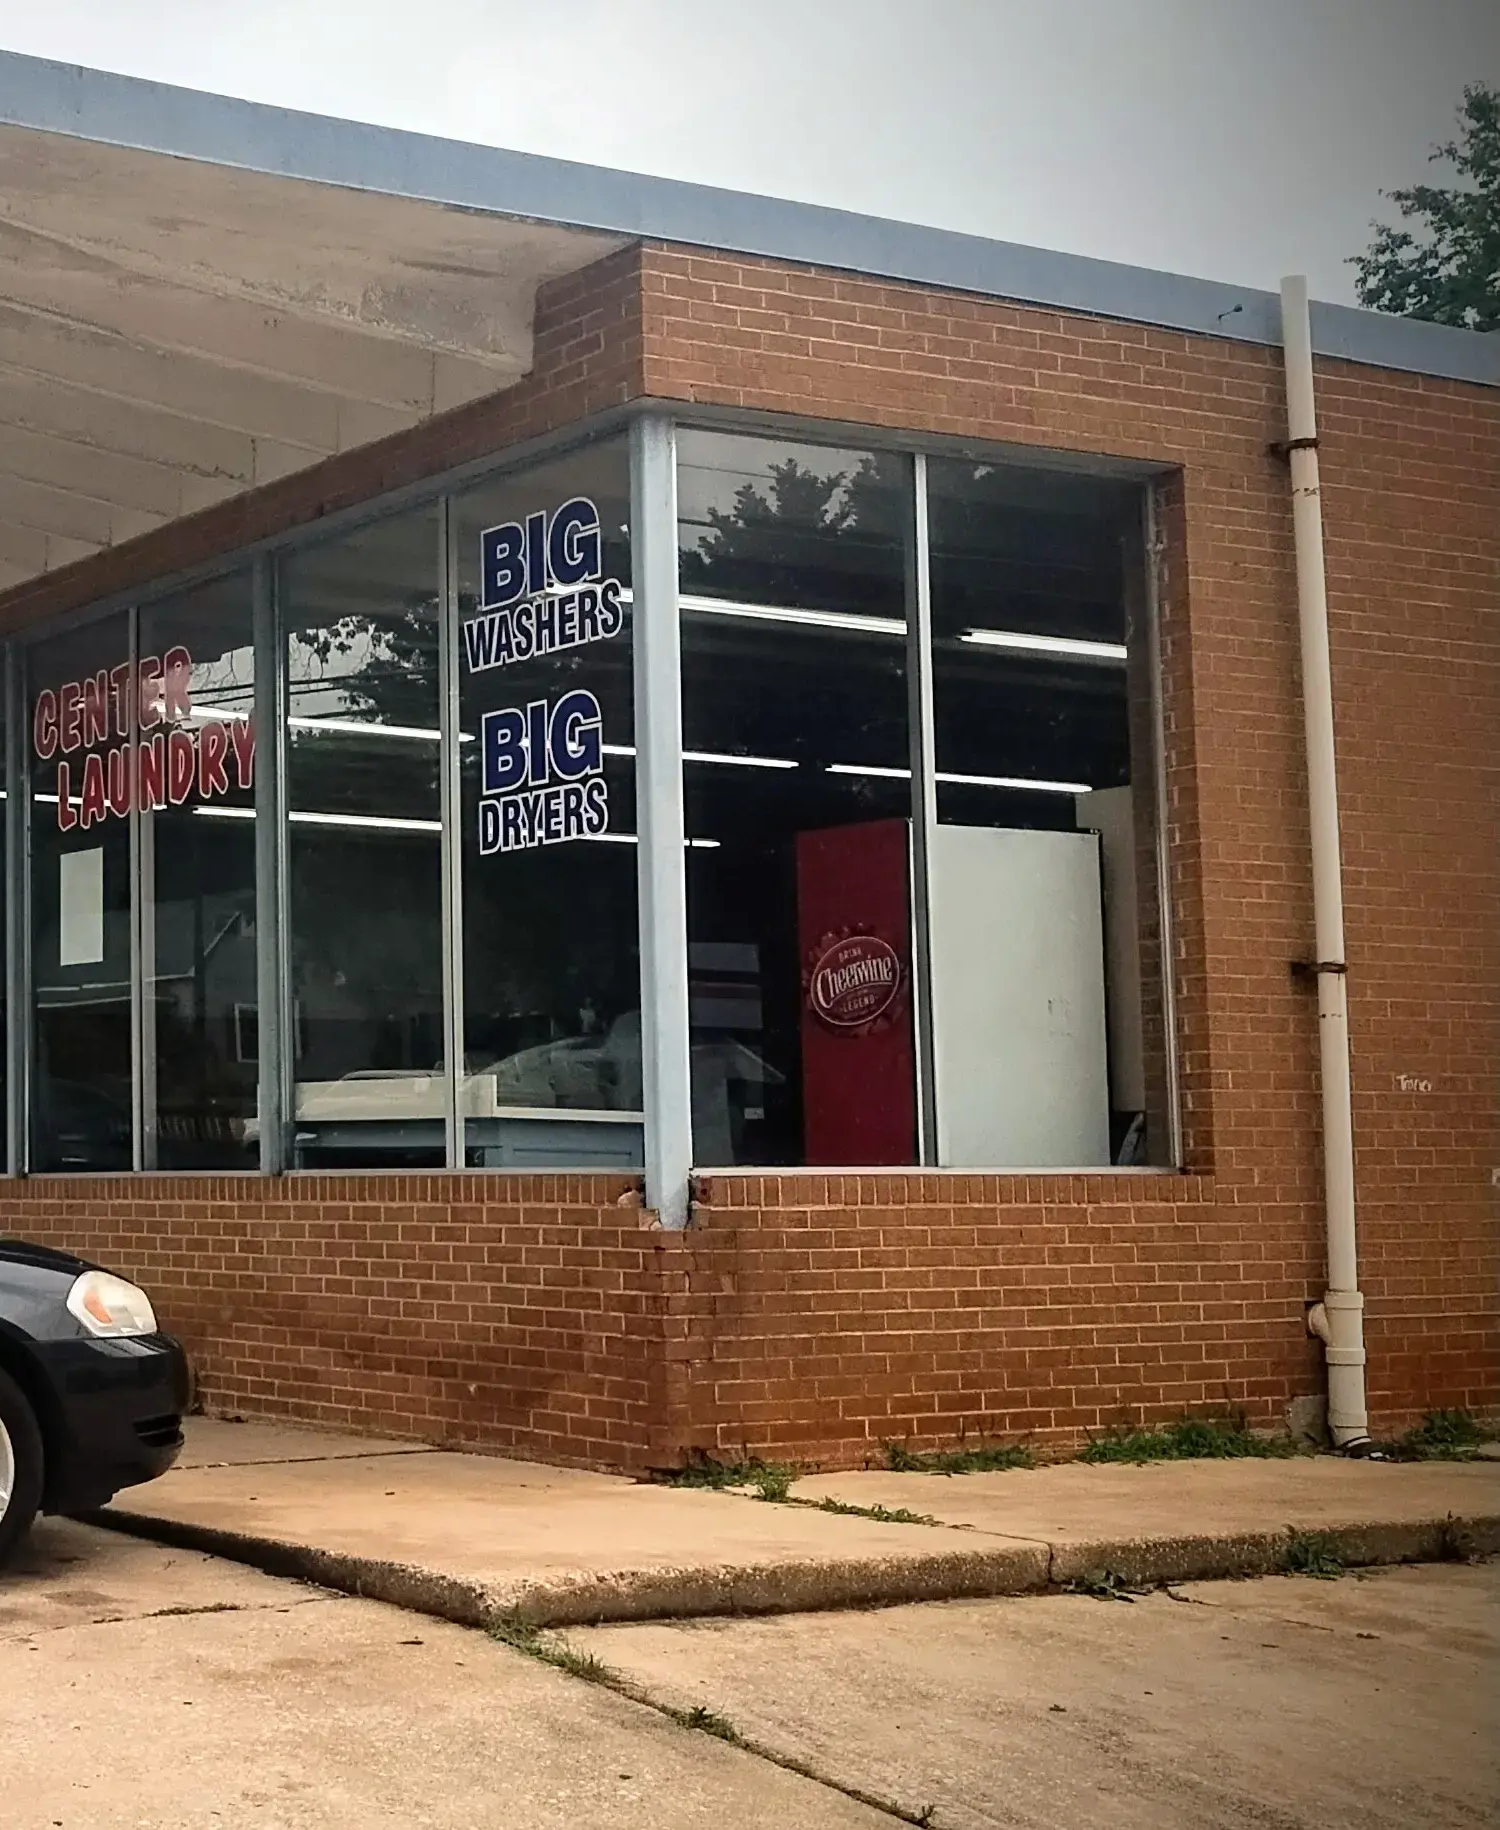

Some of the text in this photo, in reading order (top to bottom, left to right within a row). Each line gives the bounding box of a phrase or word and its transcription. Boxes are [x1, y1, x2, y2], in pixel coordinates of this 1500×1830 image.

[480, 497, 601, 611] BIG
[464, 578, 623, 673] WASHERS
[34, 645, 192, 759] CENTER
[481, 689, 603, 795] BIG
[57, 707, 256, 831] LAUNDRY
[479, 778, 608, 856] DRYERS
[816, 954, 893, 1009] Cheerwine
[843, 994, 875, 1013] LEGEND
